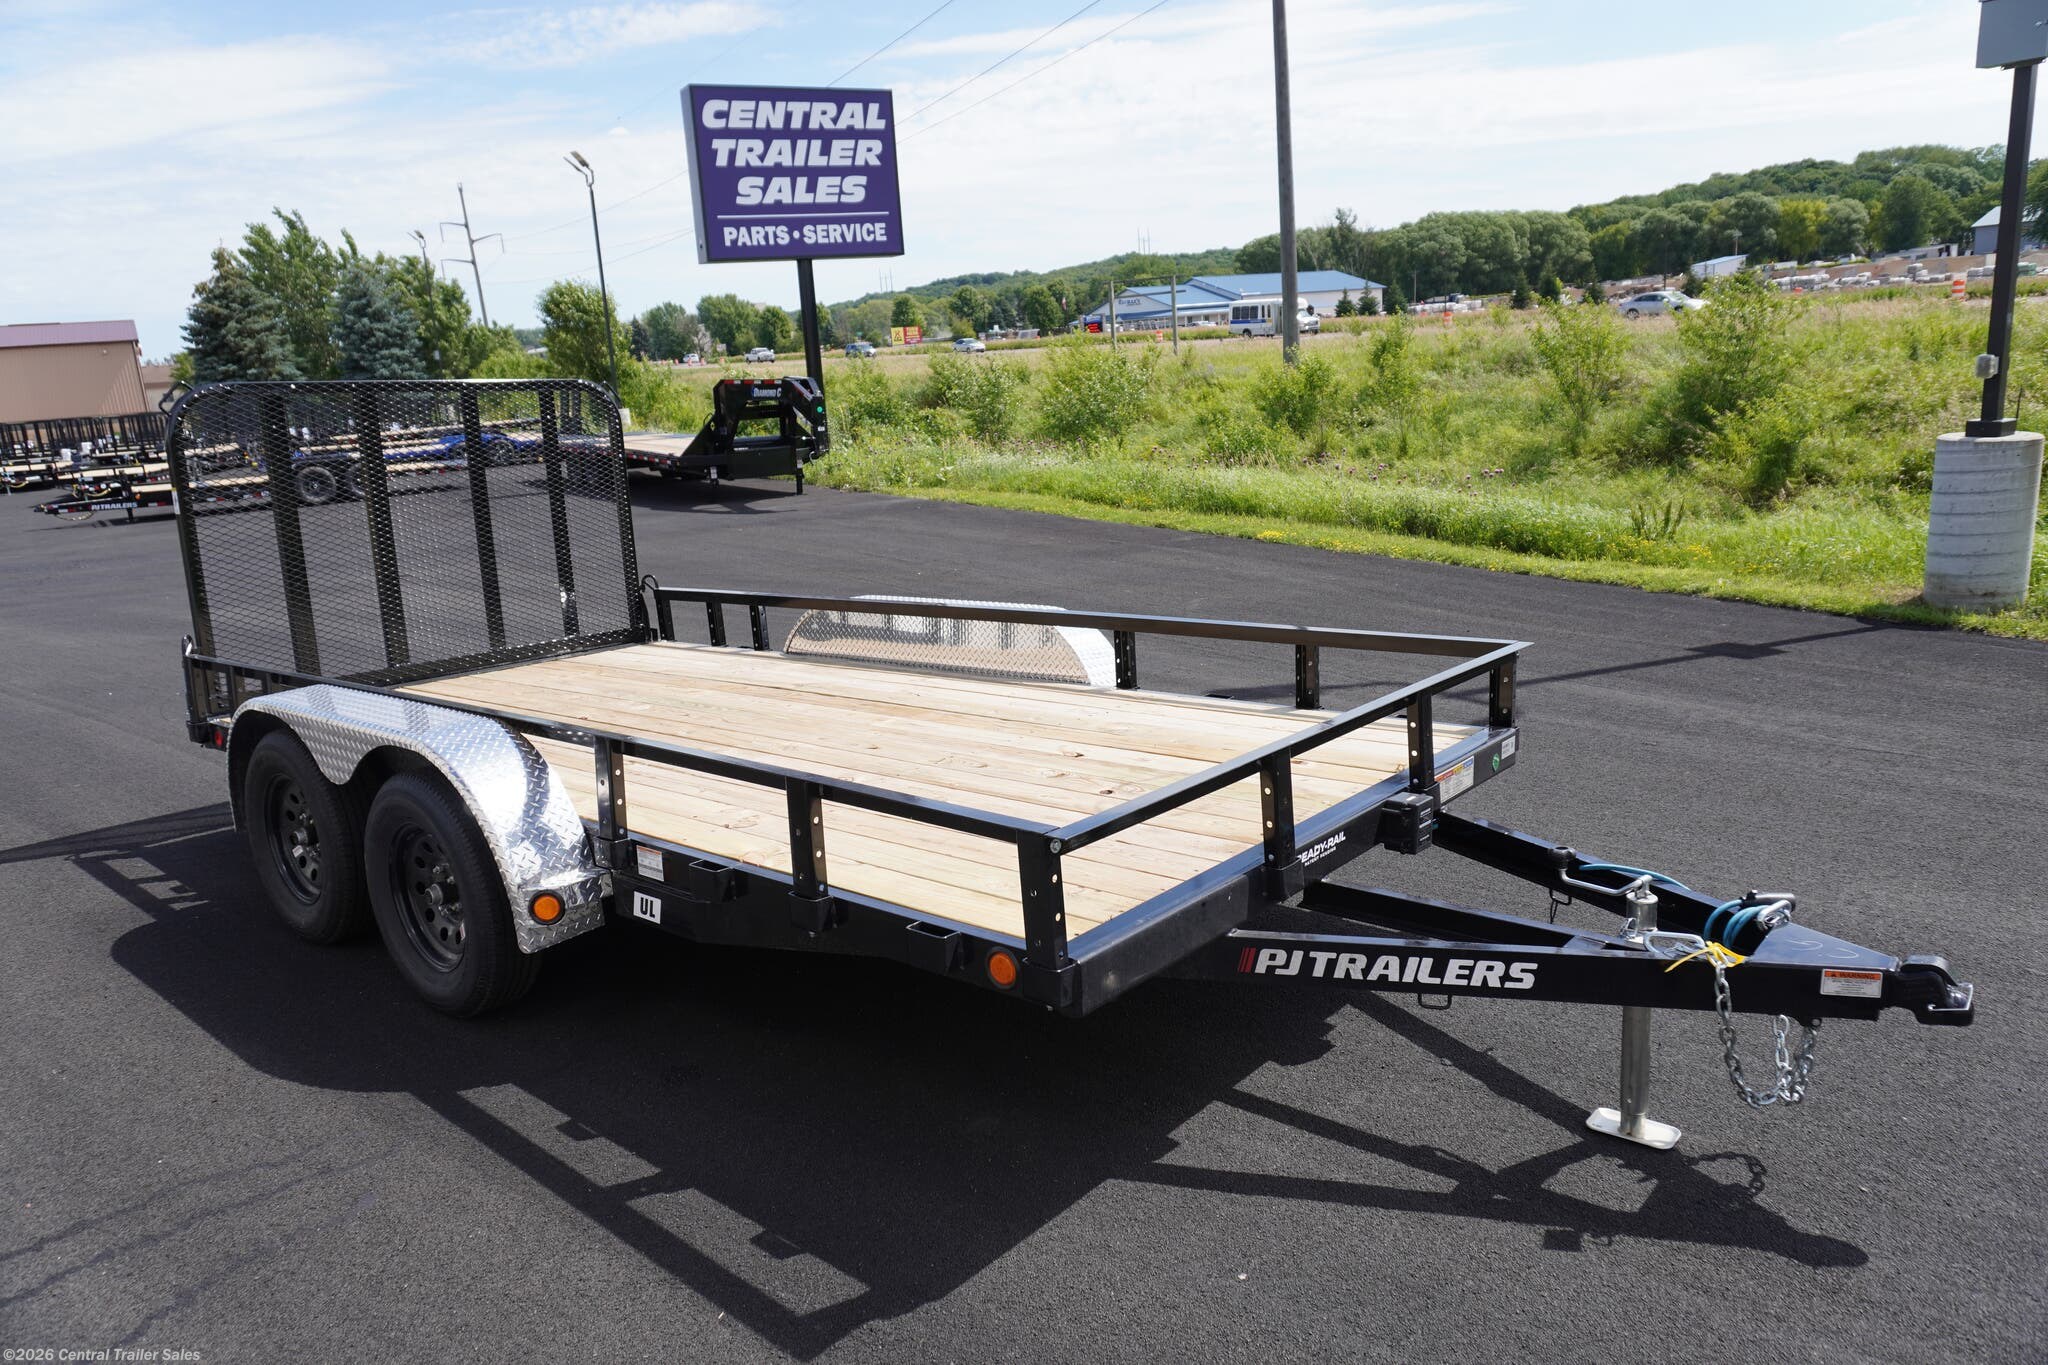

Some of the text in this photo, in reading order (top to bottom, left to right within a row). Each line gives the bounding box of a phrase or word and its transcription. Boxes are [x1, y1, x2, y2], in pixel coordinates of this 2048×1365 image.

[702, 99, 886, 130] CENTRAL
[711, 138, 883, 167] TRAILER
[736, 175, 867, 205] SALES
[723, 222, 887, 246] PARTS SERVICE
[640, 897, 655, 918] UL
[1254, 948, 1539, 989] PJ TRAILERS
[1839, 971, 1875, 980] WARNING
